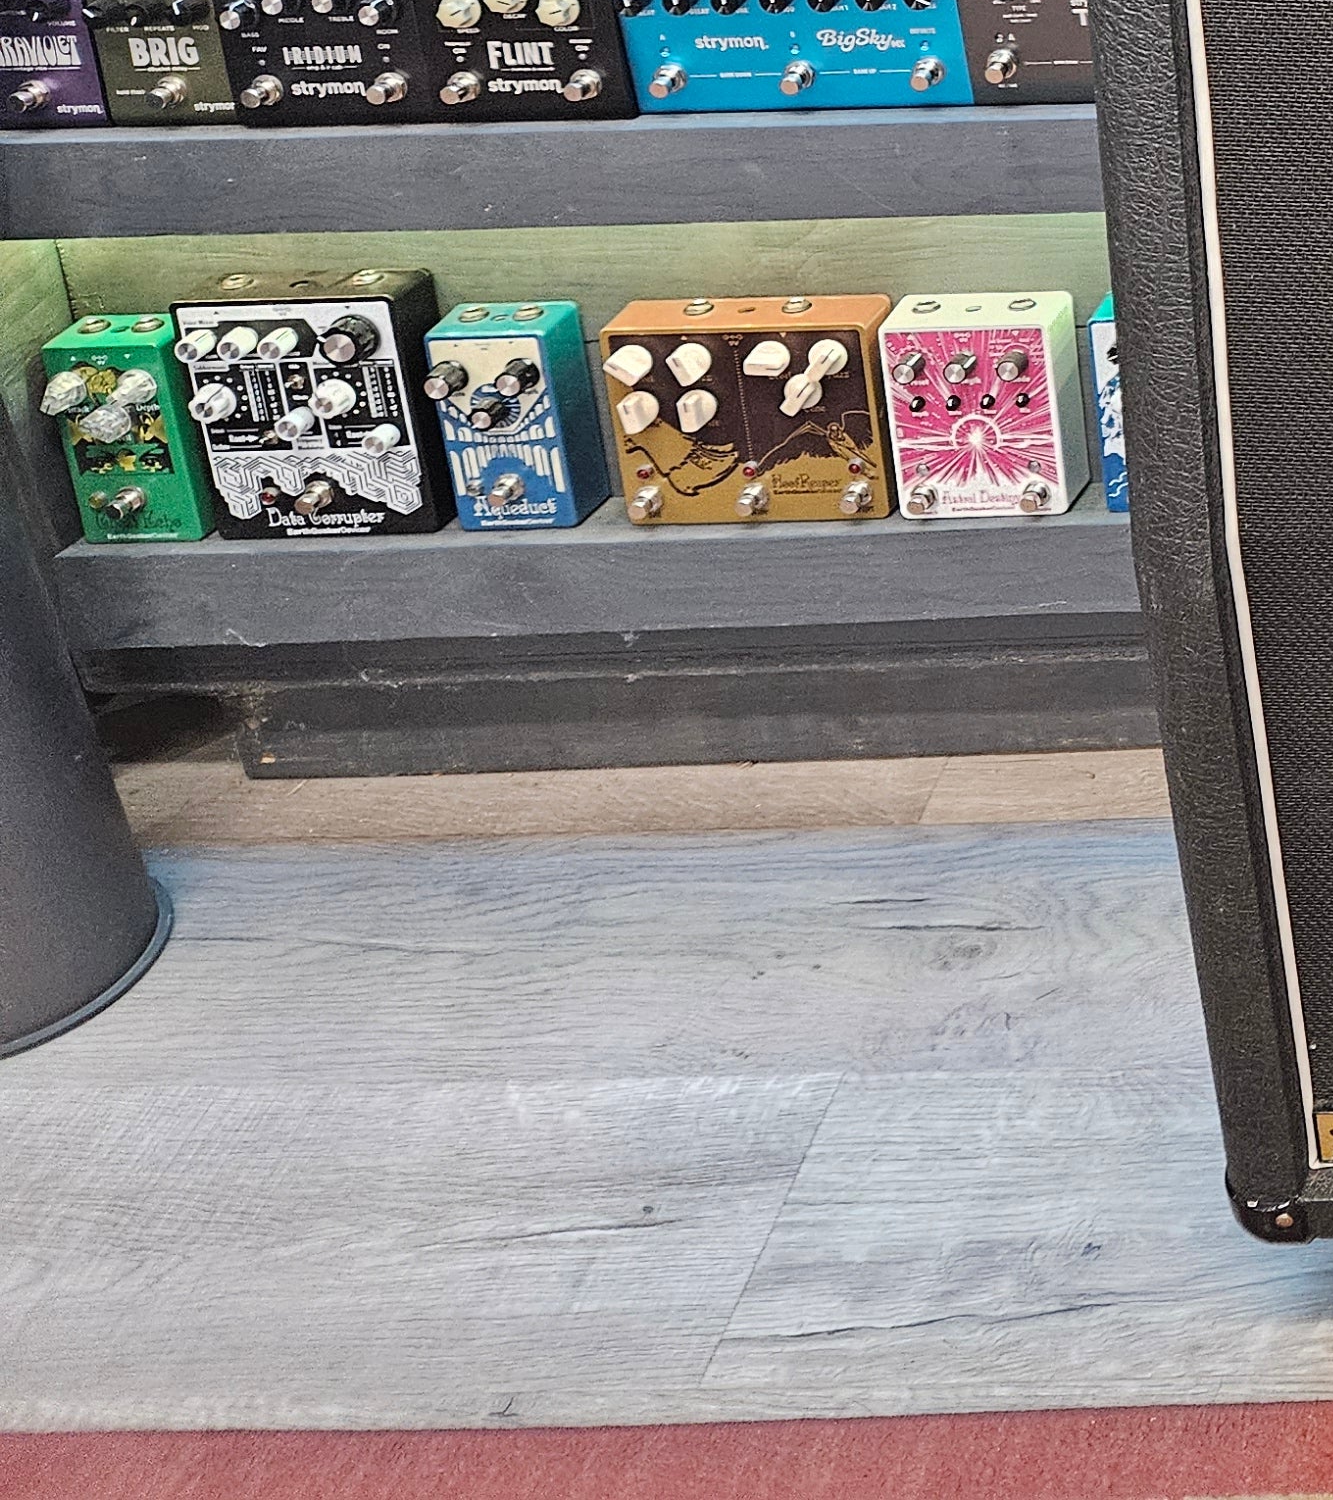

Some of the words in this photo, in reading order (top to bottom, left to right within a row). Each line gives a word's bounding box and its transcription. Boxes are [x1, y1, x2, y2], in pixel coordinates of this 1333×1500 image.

[695, 35, 769, 52] strymon
[816, 27, 895, 52] BigSky
[127, 37, 201, 67] BRIG
[281, 45, 363, 66] IRIDIUM
[485, 41, 555, 70] FLINT
[290, 77, 366, 97] strymon
[487, 77, 565, 95] strymon
[57, 104, 103, 114] strymon
[268, 507, 308, 529] Data
[310, 509, 387, 529] Corrupter
[473, 496, 558, 520] Aqueduct
